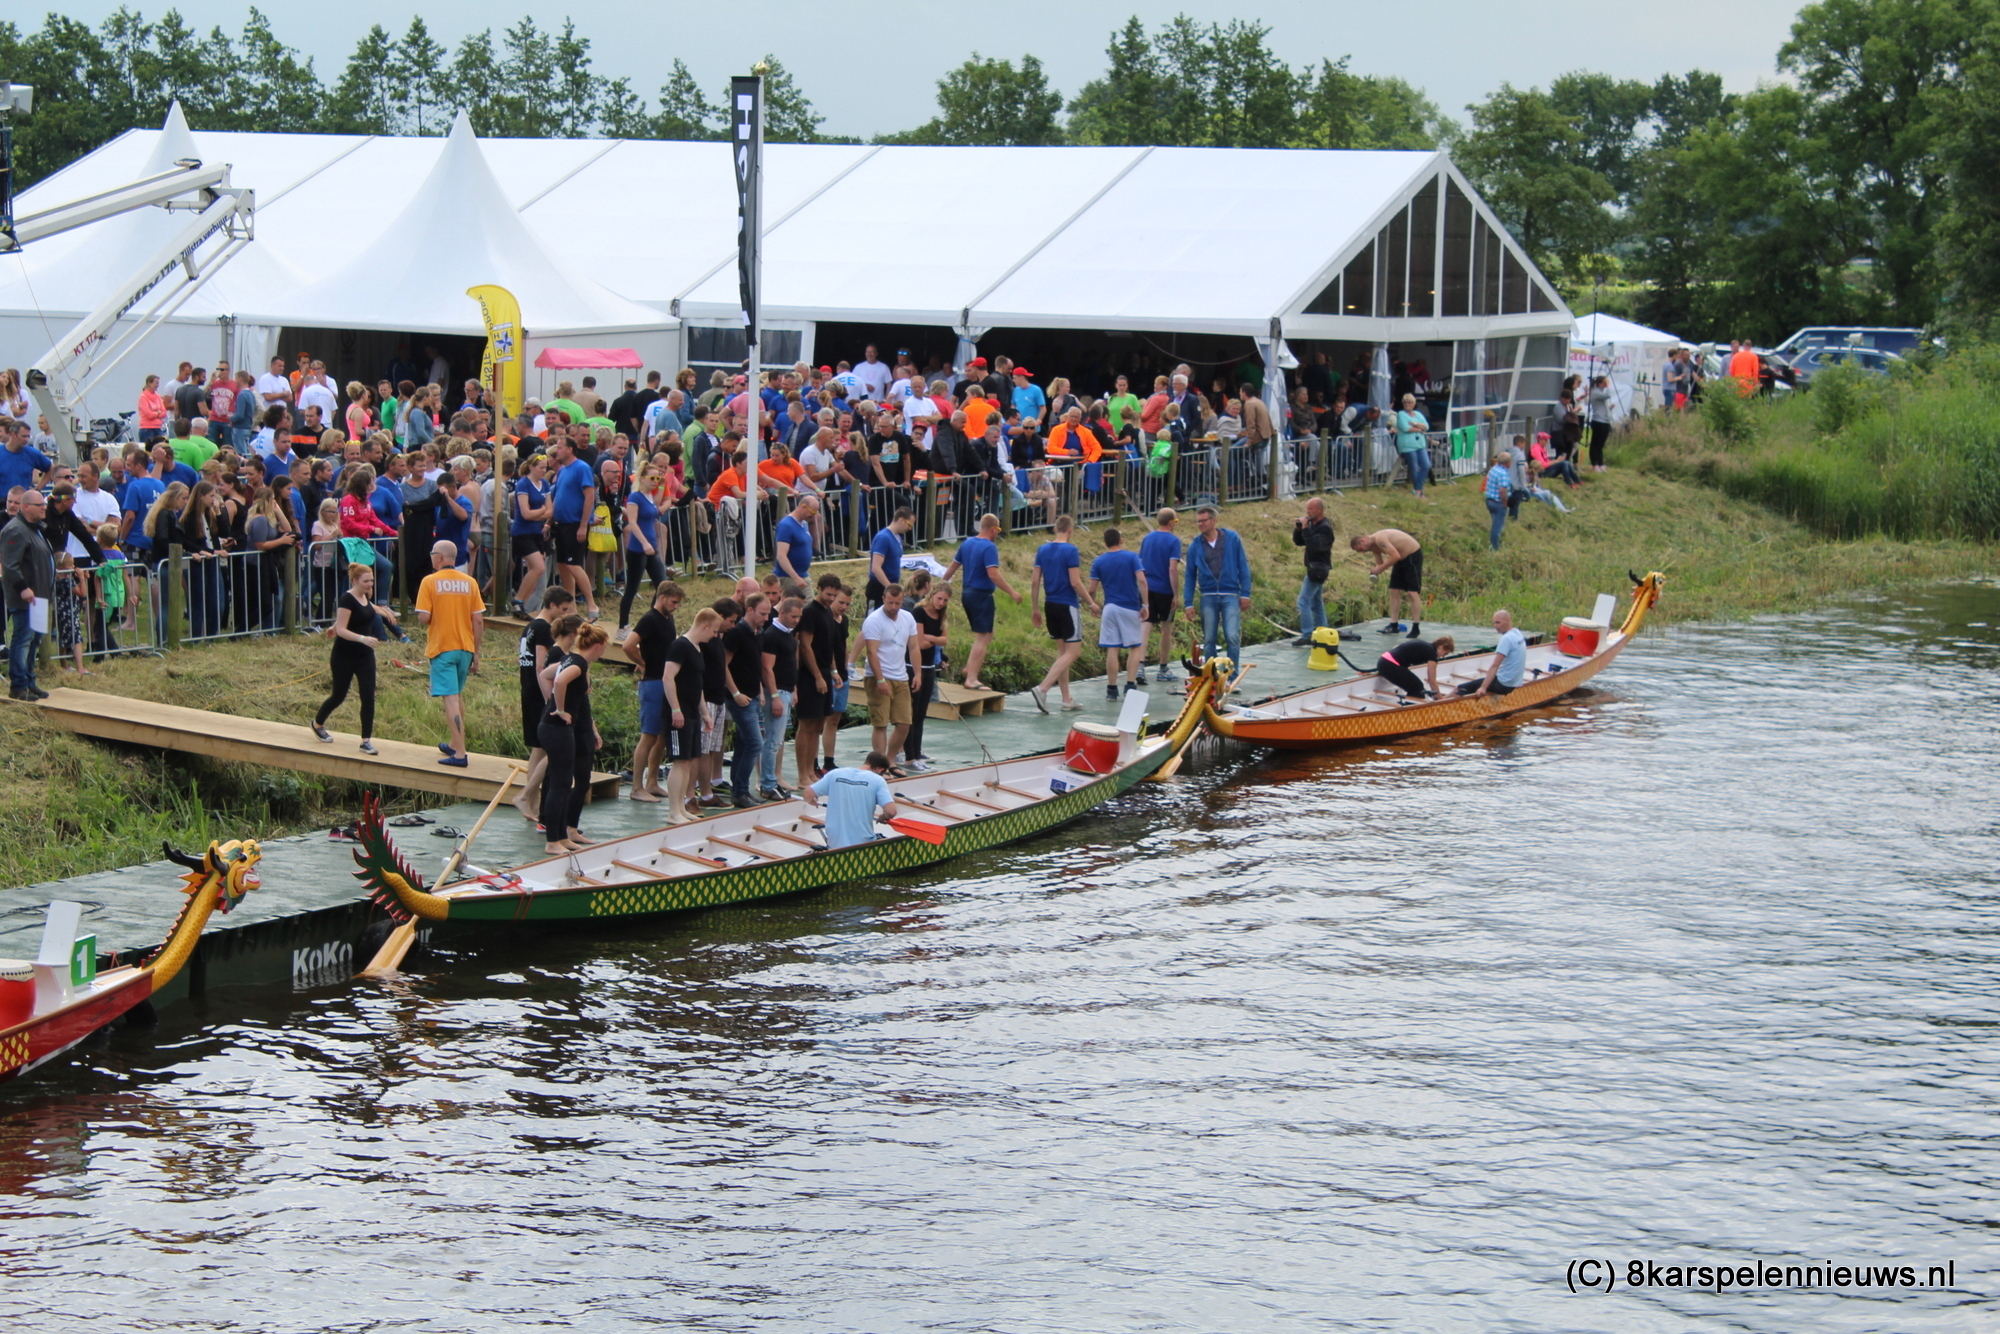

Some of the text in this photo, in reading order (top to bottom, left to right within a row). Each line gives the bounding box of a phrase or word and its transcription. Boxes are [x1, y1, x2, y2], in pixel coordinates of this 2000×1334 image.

[73, 341, 86, 357] KT
[342, 505, 356, 517] 56
[437, 580, 470, 594] JOHN
[77, 944, 88, 979] 1
